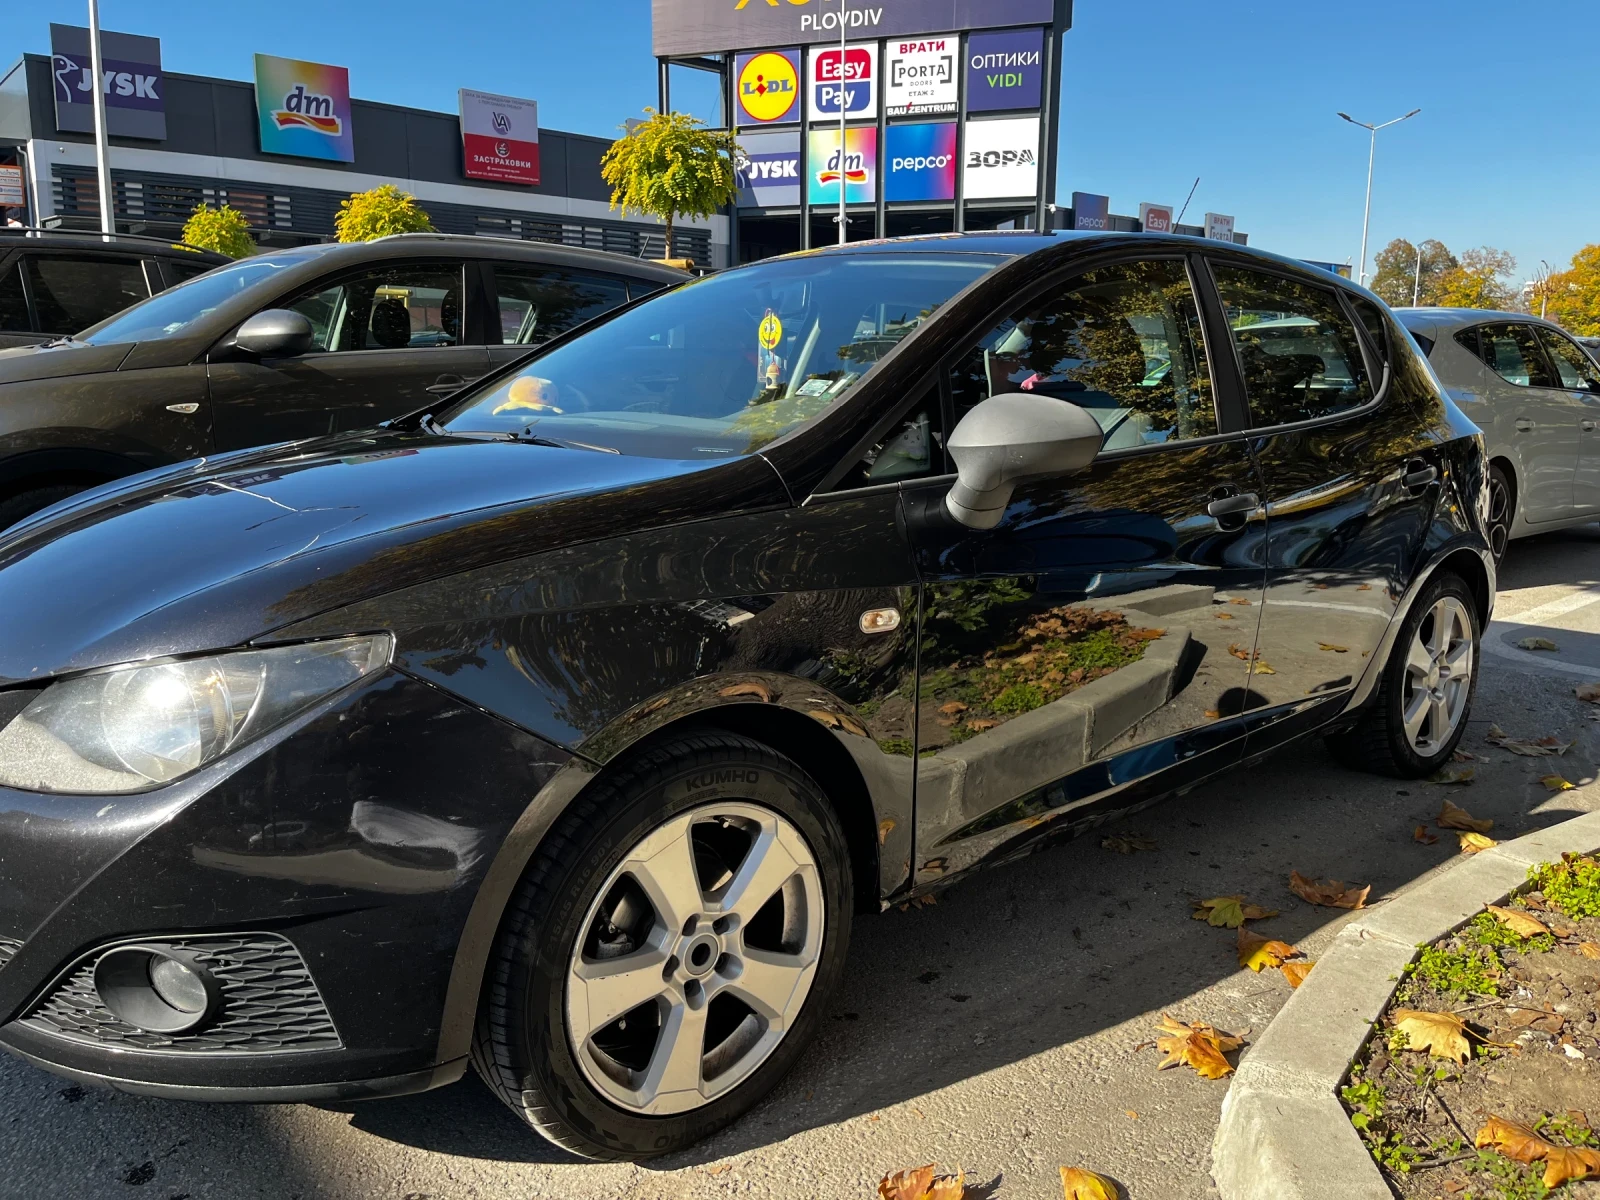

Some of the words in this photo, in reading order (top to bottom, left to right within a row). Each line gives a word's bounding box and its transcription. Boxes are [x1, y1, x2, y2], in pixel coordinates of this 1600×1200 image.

[801, 8, 882, 31] PLOVDIV
[900, 41, 945, 54] ВРАТИ
[822, 59, 865, 79] Easy
[971, 51, 1039, 69] ОПТИКИ
[899, 64, 946, 78] PORTA
[77, 68, 159, 100] JYSK
[987, 73, 1022, 88] VIDI
[286, 86, 331, 116] dm
[822, 87, 855, 109] Pay
[887, 107, 907, 115] BAU
[908, 103, 955, 114] ZENTRUM
[473, 154, 531, 168] ЗАСТРАХОВКИ
[827, 150, 861, 171] dm
[892, 155, 947, 172] pepco
[966, 149, 1036, 168] ЗОРА
[748, 160, 798, 179] JYSK
[1078, 216, 1104, 228] pepco
[1148, 214, 1169, 229] Easy
[1213, 216, 1231, 226] ВРАТИ
[1212, 231, 1231, 241] PORTA
[686, 769, 759, 792] KUMHO
[547, 899, 572, 954] 215/45
[570, 868, 591, 897] R16
[591, 837, 613, 866] 90V
